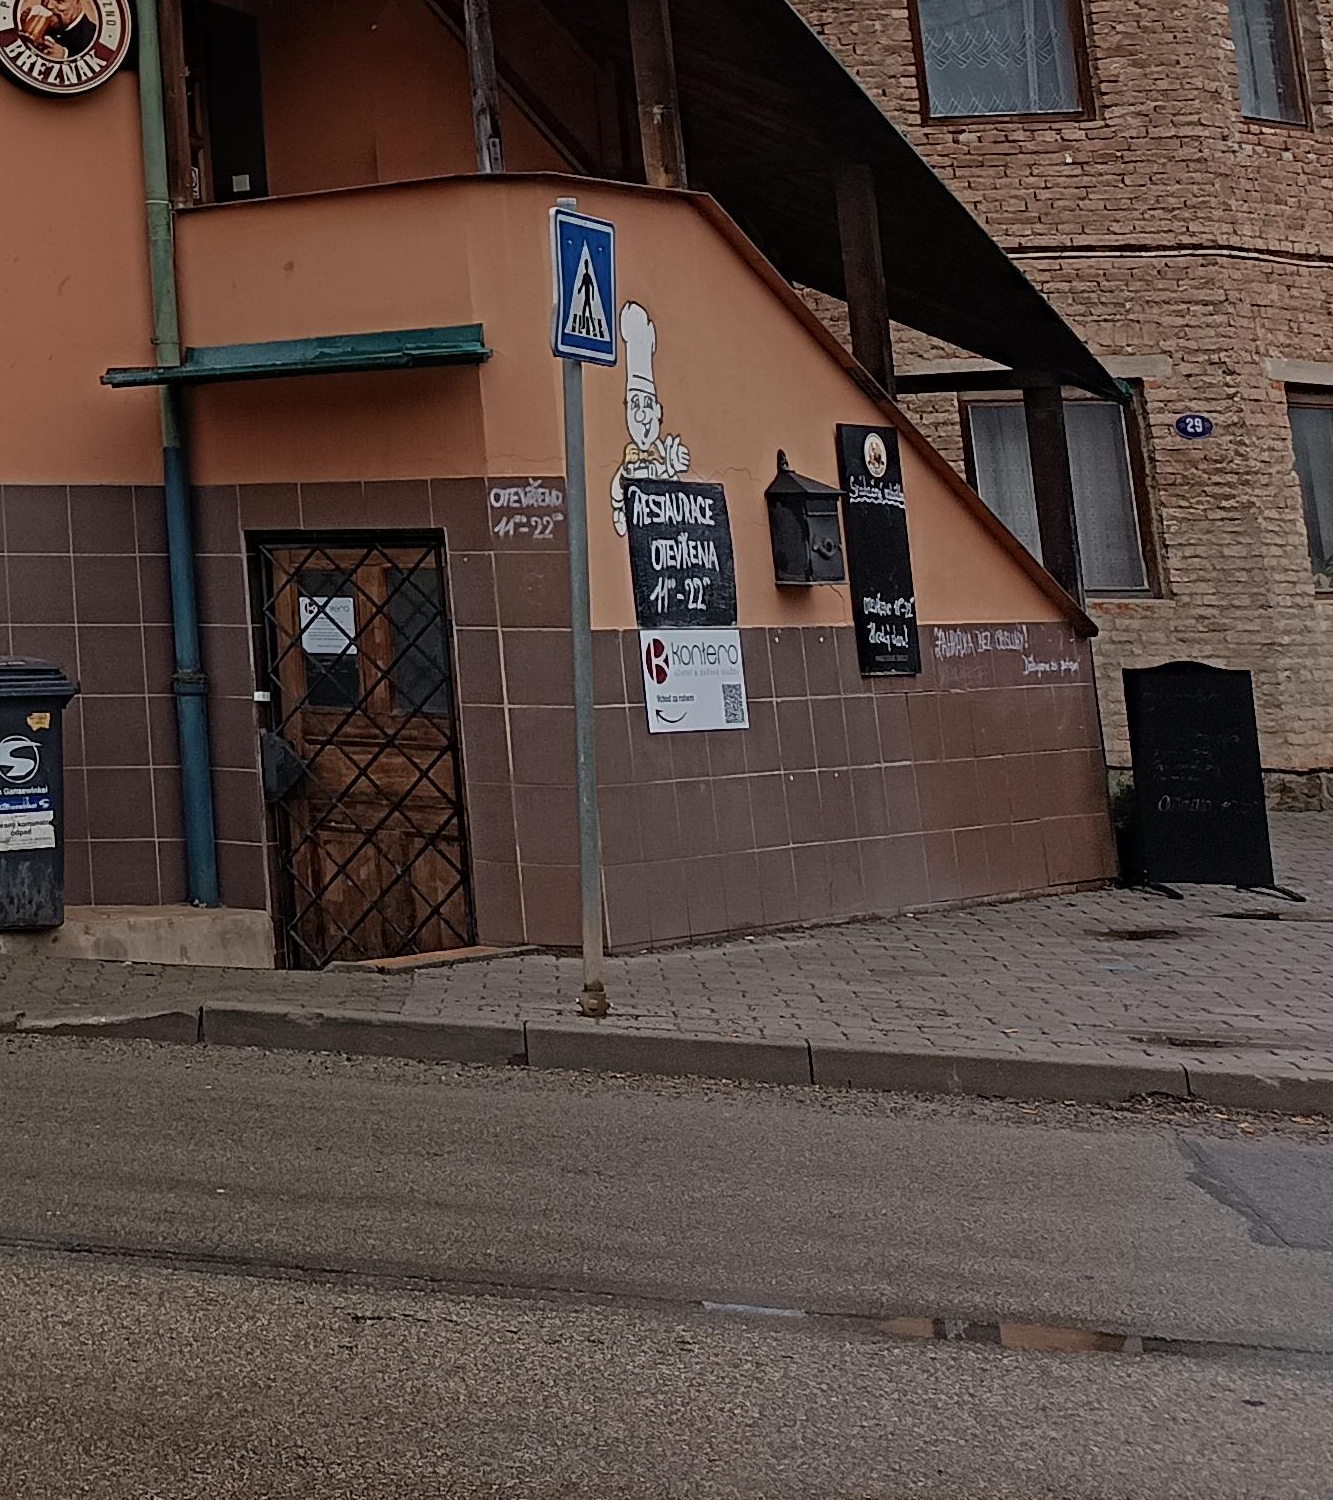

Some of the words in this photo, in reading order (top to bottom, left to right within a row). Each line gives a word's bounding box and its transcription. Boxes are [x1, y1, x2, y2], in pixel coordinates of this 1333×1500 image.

[3, 39, 108, 86] BŘEZŇÁK
[1185, 417, 1203, 433] 29
[489, 477, 564, 509] OTEVŘENO
[627, 485, 716, 528] RESTAURACE
[650, 531, 721, 573] OTEVŘENA
[671, 642, 739, 666] kontero
